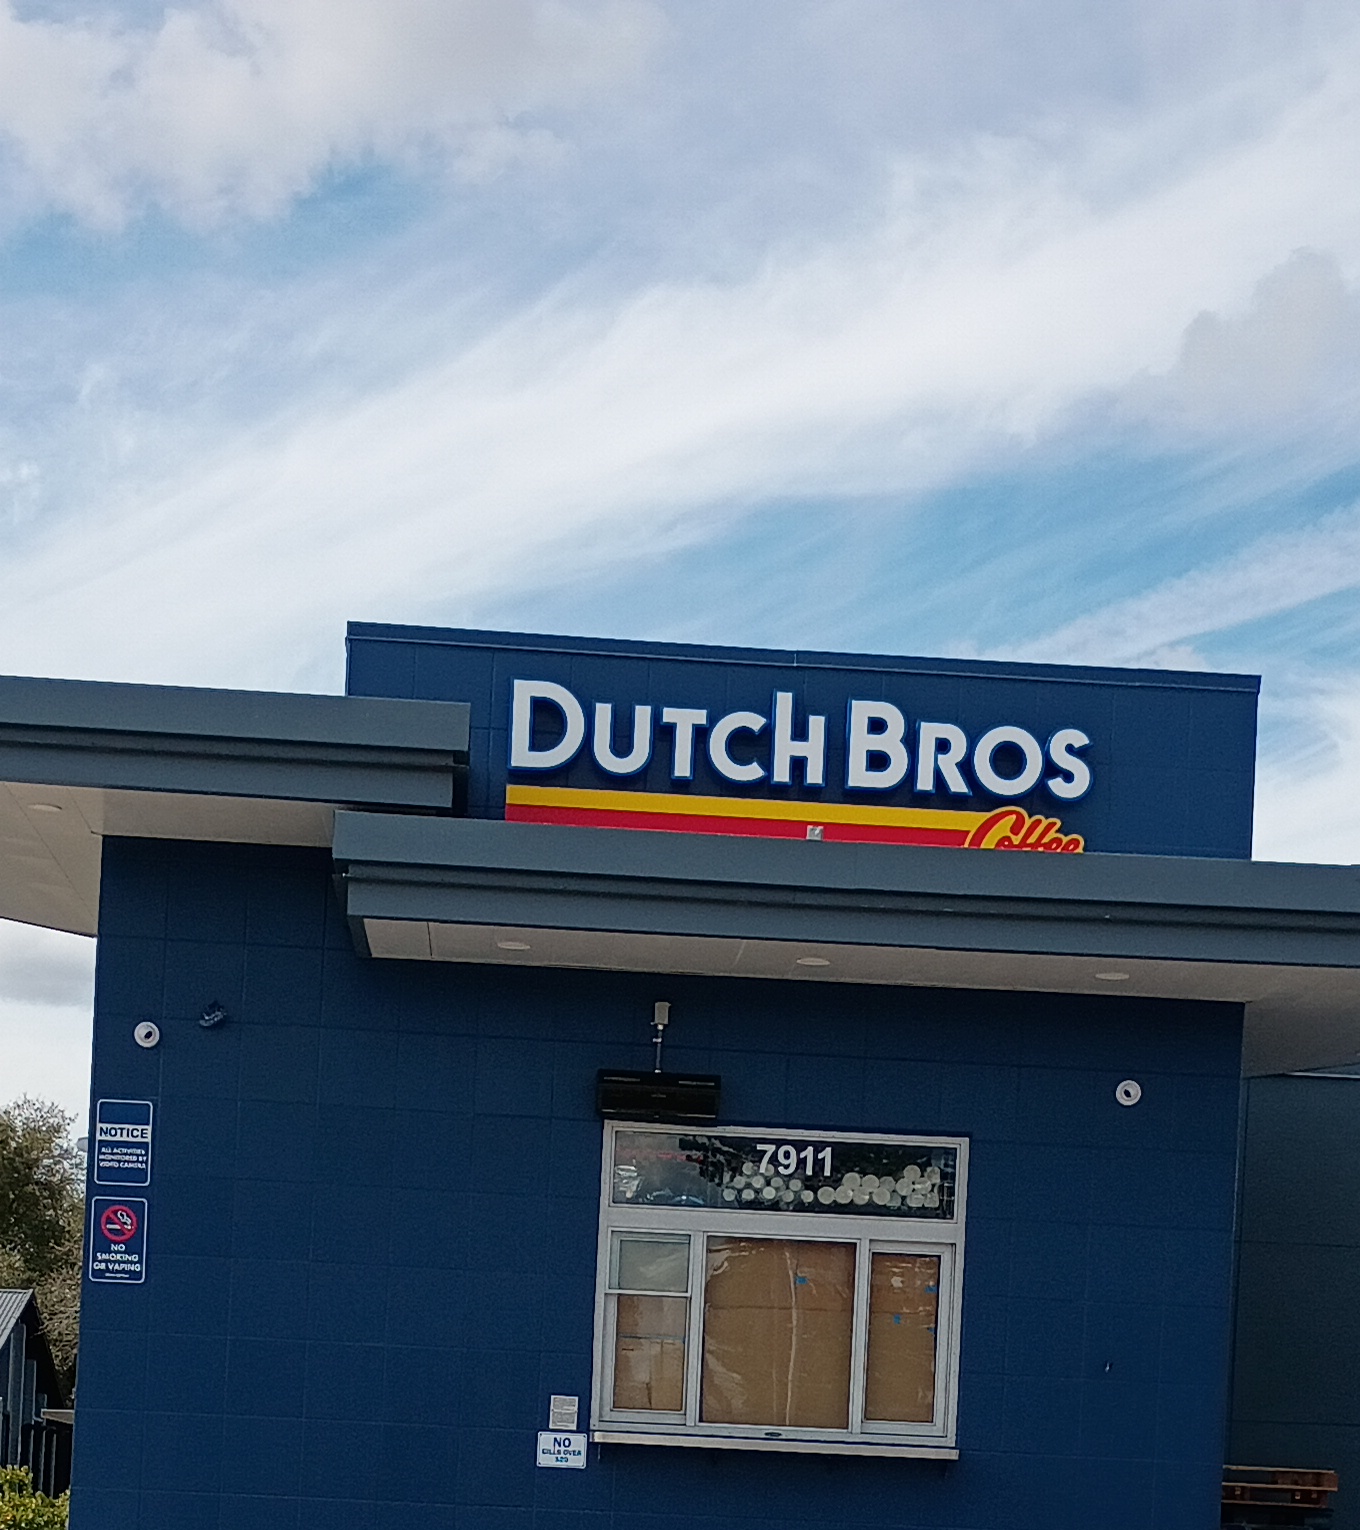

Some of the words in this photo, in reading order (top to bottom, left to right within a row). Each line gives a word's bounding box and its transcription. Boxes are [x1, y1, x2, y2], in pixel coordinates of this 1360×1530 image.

[510, 678, 824, 785] DUTCH
[847, 700, 1092, 799] BROS
[99, 1126, 148, 1139] NOTICE
[120, 1161, 146, 1169] CAMERA
[756, 1144, 832, 1177] 7911
[111, 1243, 125, 1251] NO
[96, 1252, 139, 1262] SMOKING
[93, 1261, 106, 1270] OR
[107, 1262, 141, 1272] VAPING
[554, 1437, 571, 1448] NO
